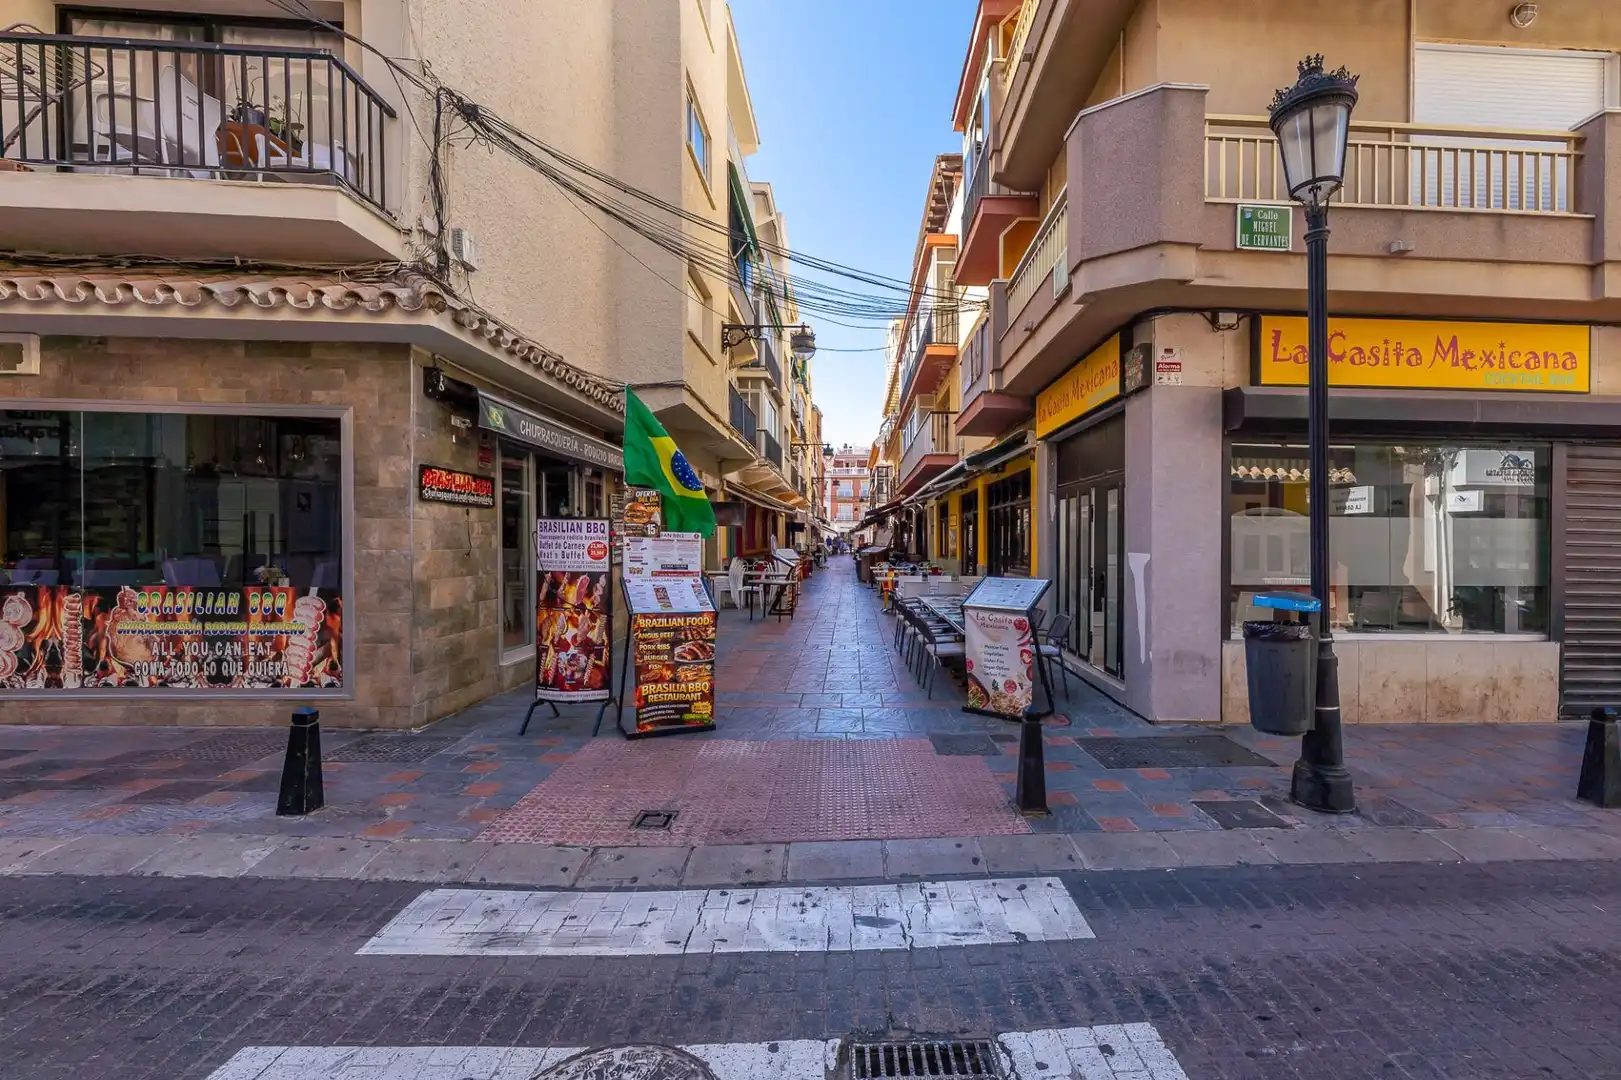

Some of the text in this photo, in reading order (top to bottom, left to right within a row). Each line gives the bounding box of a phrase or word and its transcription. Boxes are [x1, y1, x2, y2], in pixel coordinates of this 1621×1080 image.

[1253, 221, 1277, 233] MIGUEL
[1241, 234, 1289, 247] DE CERVANTES
[1272, 329, 1578, 371] La Casita Mexicana
[1047, 391, 1070, 417] Casita
[1072, 360, 1117, 400] Mexicana
[520, 420, 579, 452] CHURRASQUERÍA
[635, 490, 657, 498] OFERTA
[539, 521, 606, 534] BRASILIAN BBQ
[647, 524, 655, 535] 15
[563, 541, 586, 550] Carnes
[561, 551, 585, 559] Buffet
[136, 591, 288, 617] BRASILIAN BBQ
[640, 616, 710, 628] BRAZILIAN FOOD
[976, 612, 1013, 625] La Casita
[151, 641, 272, 656] ALL YOU CAN EAT
[170, 661, 198, 676] TODO
[203, 661, 217, 676] LO
[221, 661, 243, 676] QUE
[248, 661, 290, 676] QUIERA
[642, 681, 710, 696] BRASILIA BBQ
[648, 692, 703, 703] RESTAURANT
